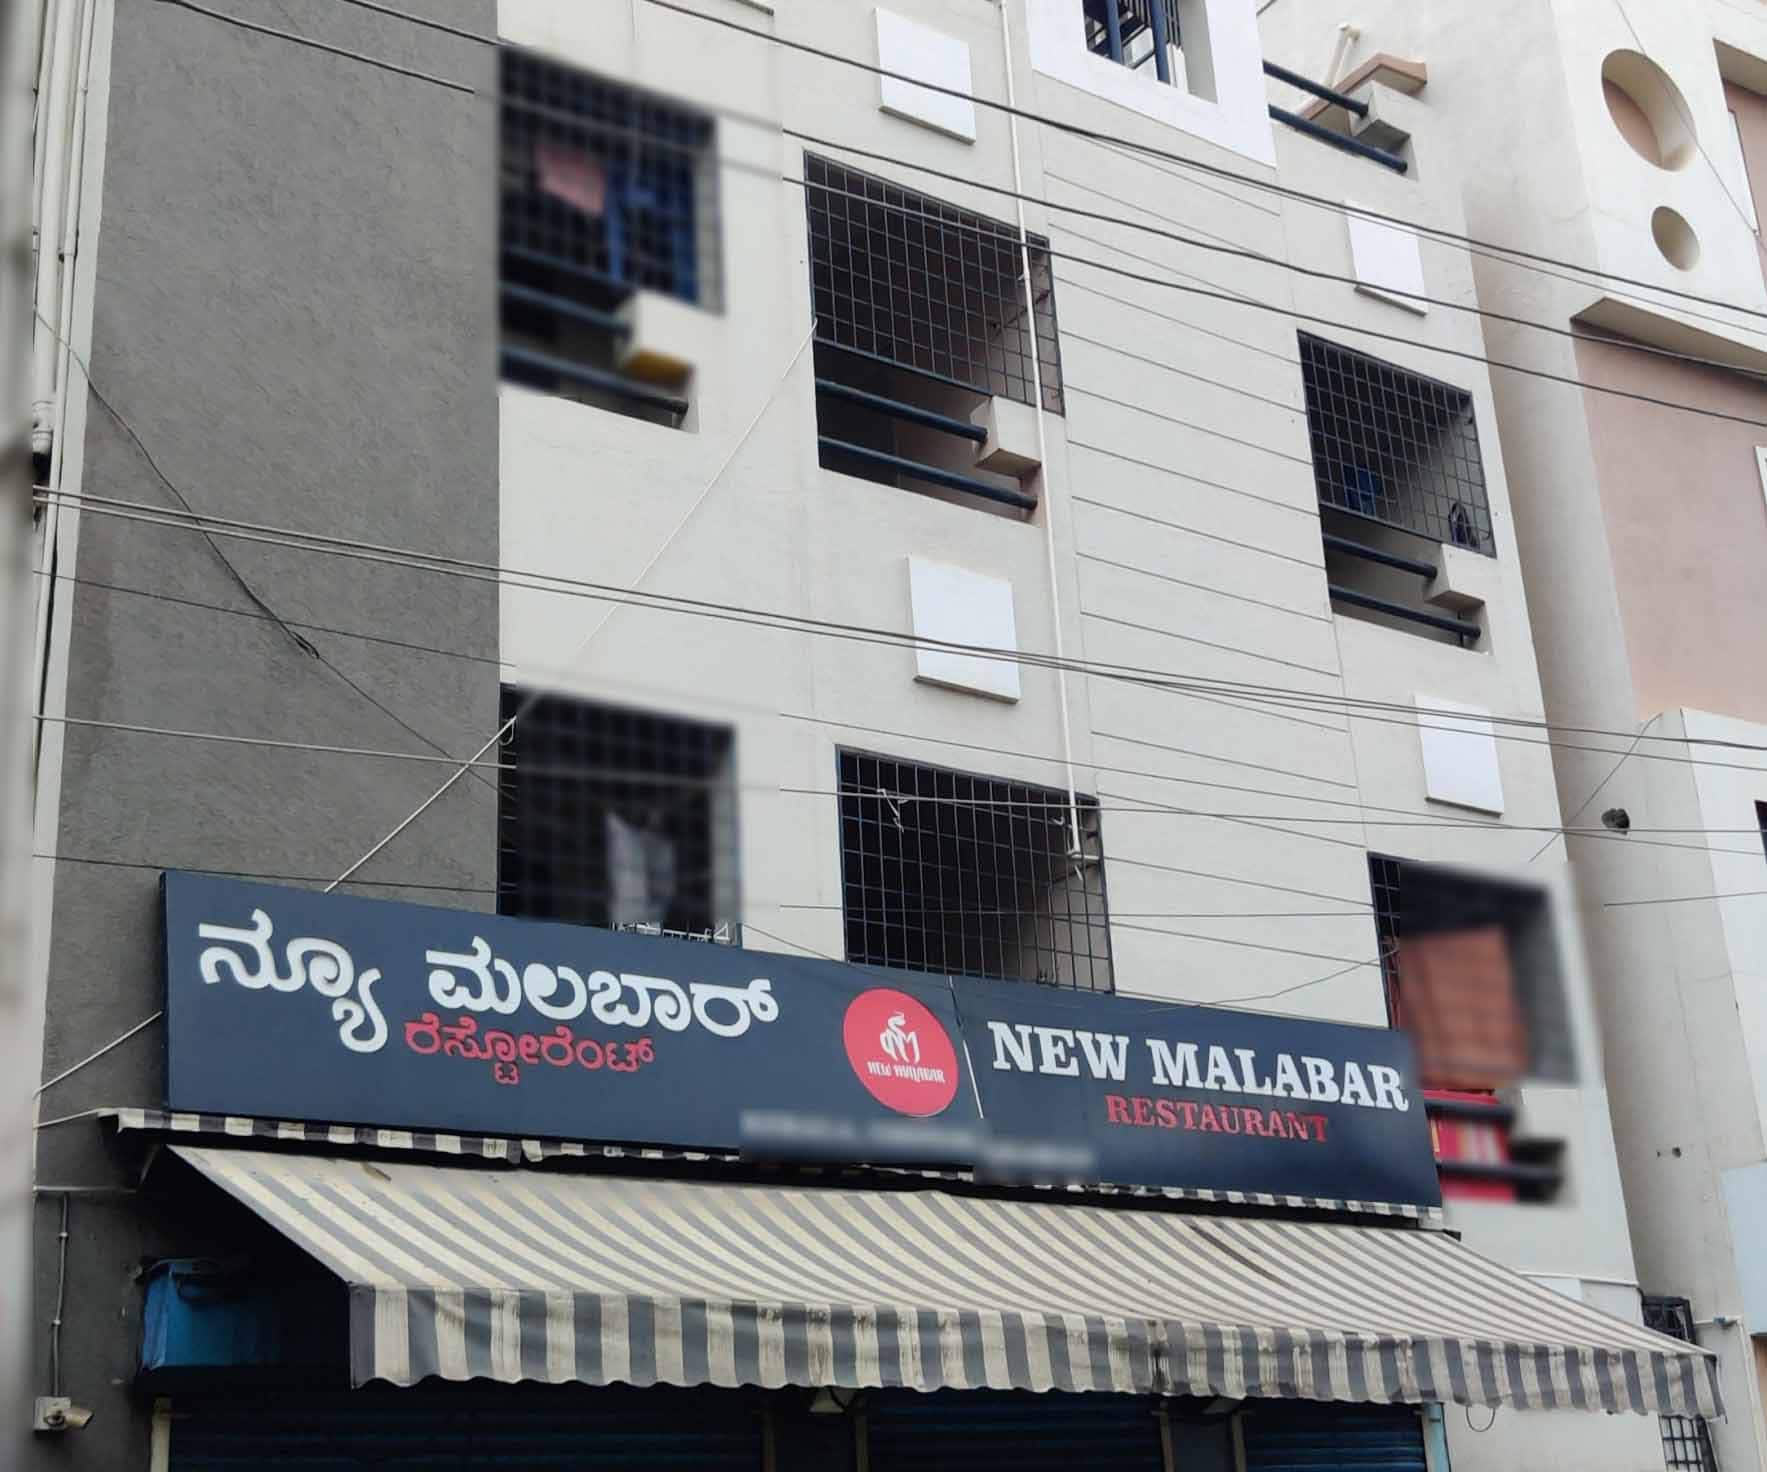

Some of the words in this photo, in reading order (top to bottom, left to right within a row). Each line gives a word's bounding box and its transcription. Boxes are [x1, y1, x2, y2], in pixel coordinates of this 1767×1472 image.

[198, 908, 388, 1053] ನ್ಯೂ
[425, 935, 779, 1038] ಮಲಬಾರ್
[404, 1012, 655, 1085] ರೆಸ್ಟೋರೆಂಟ್
[988, 1020, 1130, 1081] NEW
[1146, 1037, 1409, 1112] MALABAR
[1106, 1094, 1329, 1144] RESTAURANT
